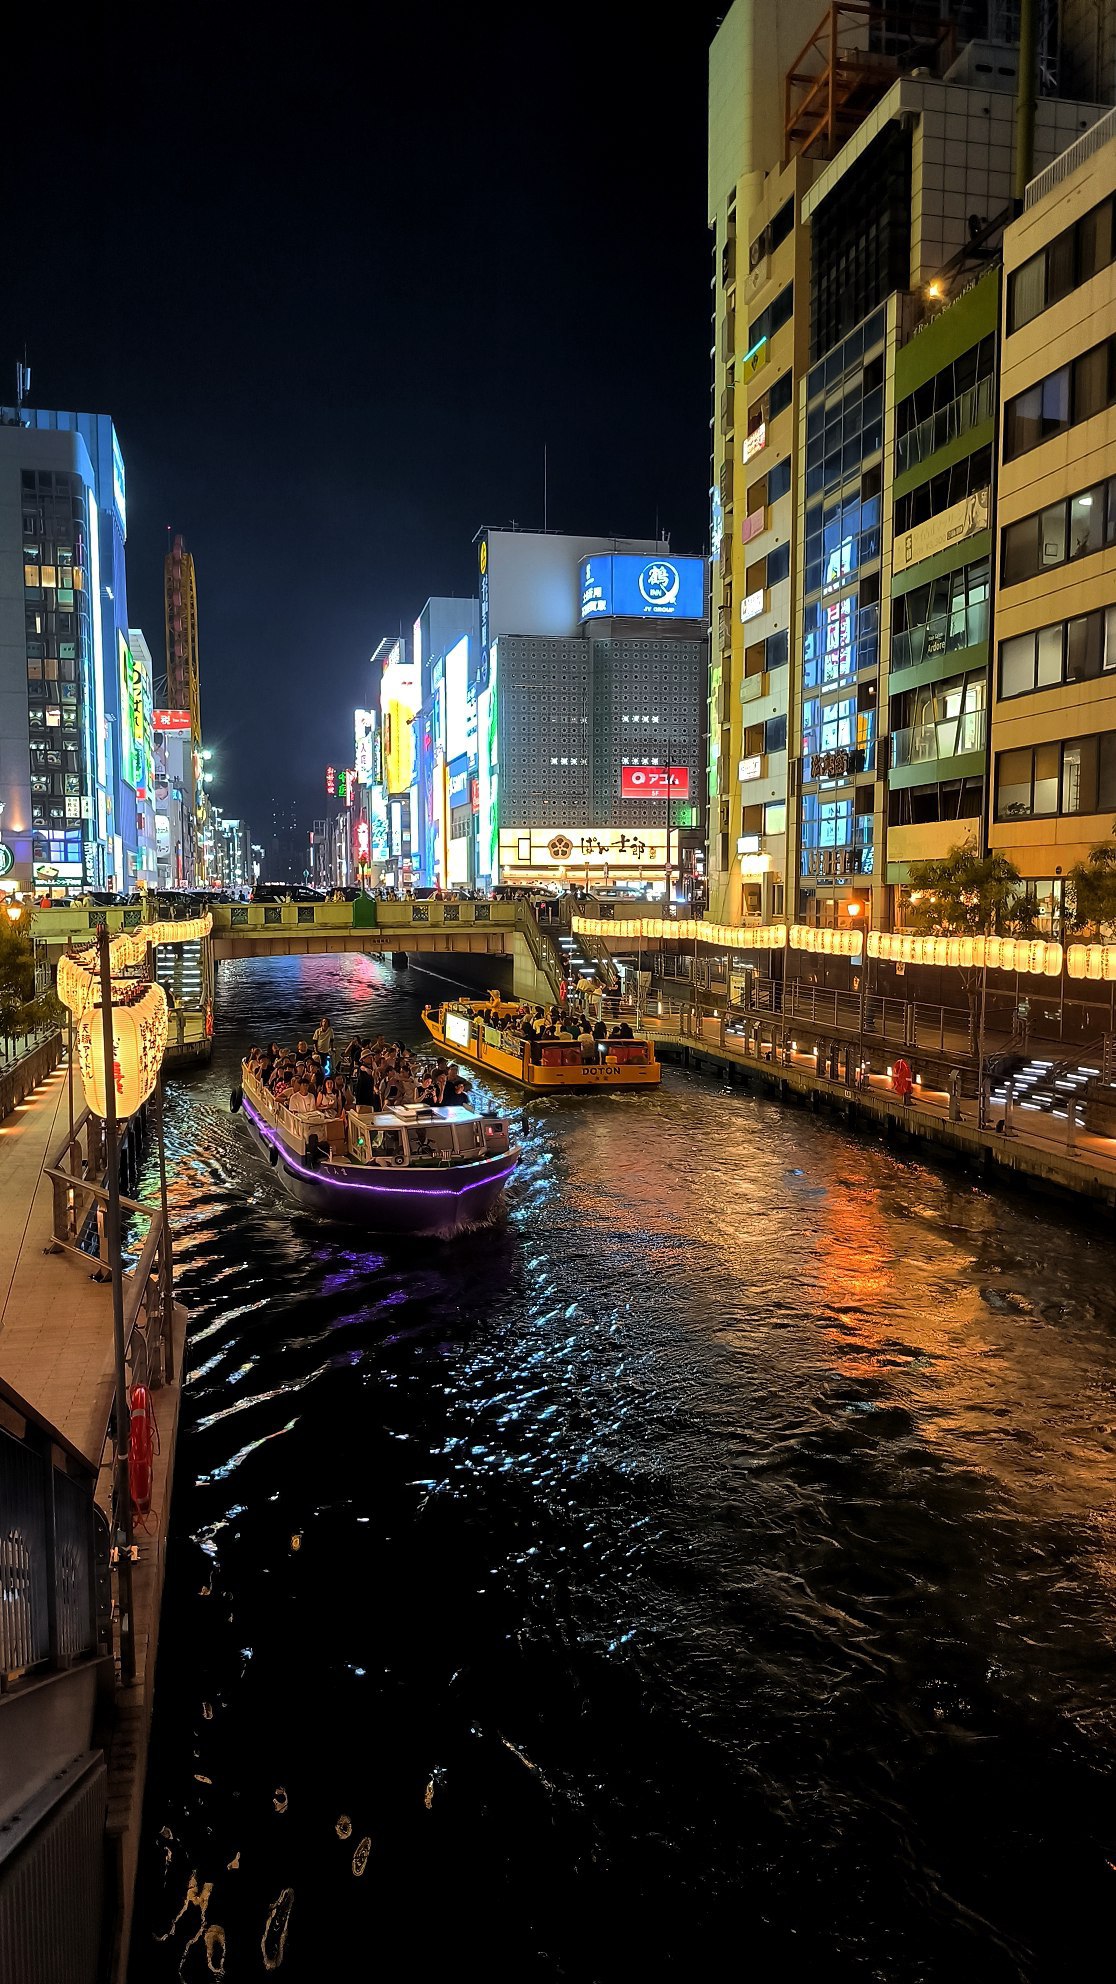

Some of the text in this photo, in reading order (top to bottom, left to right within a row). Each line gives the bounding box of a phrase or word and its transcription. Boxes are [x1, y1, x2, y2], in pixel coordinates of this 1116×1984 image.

[648, 773, 679, 785] アコム
[582, 1067, 621, 1076] DOTON
